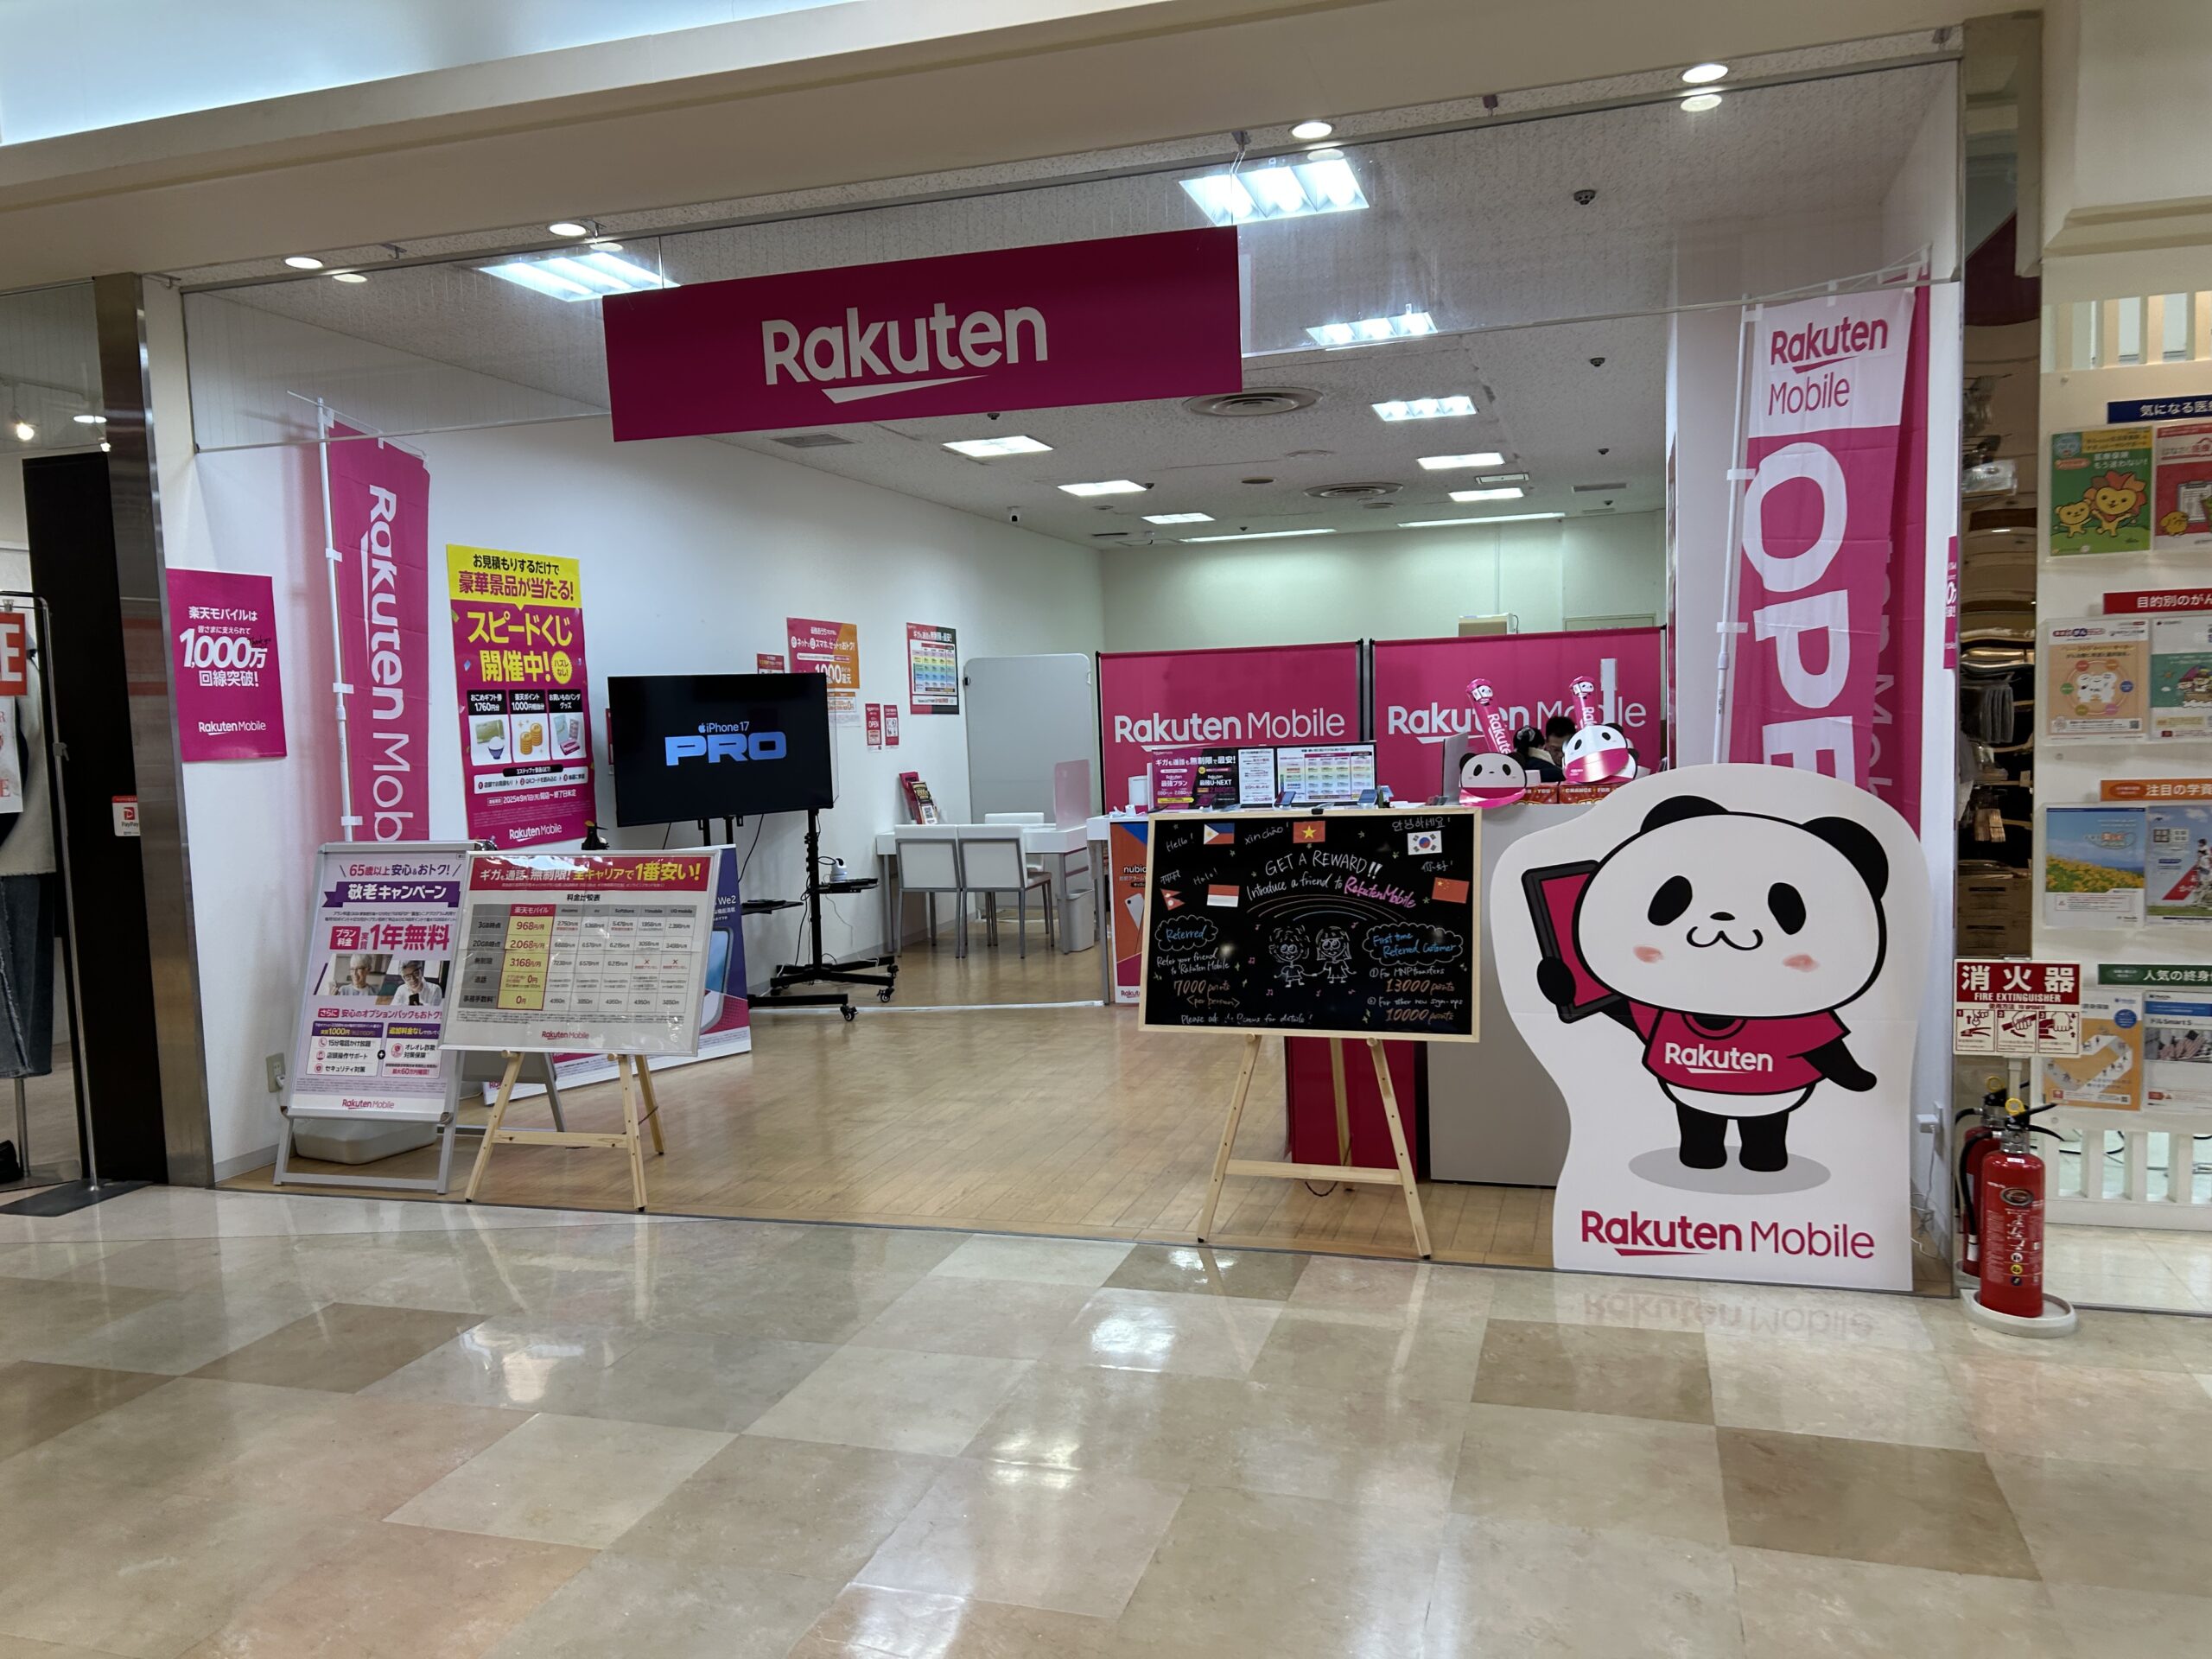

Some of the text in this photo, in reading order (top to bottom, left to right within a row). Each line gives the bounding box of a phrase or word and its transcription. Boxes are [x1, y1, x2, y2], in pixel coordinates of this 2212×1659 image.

[761, 303, 1048, 385] Rakuten
[1771, 317, 1888, 365] Rakuten
[1769, 372, 1850, 416] Mobile
[2139, 401, 2212, 416] 気になる医
[473, 554, 559, 575] お見積もりするだけで
[458, 570, 574, 601] 豪華景品が当たる!
[188, 606, 258, 621] 楽天モバイルは
[1742, 442, 1856, 786] OPE
[467, 610, 573, 646] スピードくじ
[370, 485, 413, 842] Rakuten Mob
[480, 650, 551, 682] 開催中!
[199, 671, 259, 687] 回線突破!
[1115, 708, 1344, 743] Rakuten Mobile
[1388, 702, 1529, 735] Rakuen
[1537, 696, 1646, 728] Mole
[198, 721, 266, 733] Rakuten Mobile
[706, 721, 749, 733] iPhone 17
[1487, 713, 1511, 753] Rakute
[664, 731, 787, 766] PRO
[509, 823, 562, 840] Rakuten Mobile
[1166, 832, 1194, 852] Hello!
[349, 864, 390, 876] 65歳以上
[1265, 854, 1294, 876] GET
[1299, 853, 1306, 865] A
[347, 883, 447, 900] 敬老キャンペーン
[1247, 880, 1287, 901] Introduce
[1300, 871, 1332, 887] friend
[1335, 876, 1343, 889] to
[718, 895, 736, 905] We2
[337, 938, 353, 947] 料金
[370, 924, 450, 950] 1年無料
[1166, 925, 1207, 942] Referred
[1193, 947, 1218, 961] friend
[1961, 965, 2075, 993] 消火器
[2143, 969, 2212, 982] 人気の終身
[1173, 980, 1206, 995] 7000
[1386, 979, 1431, 993] 13000
[1974, 993, 2062, 1002] FIRE EXTINGUISHER
[320, 1009, 339, 1018] さらに
[1386, 1007, 1429, 1021] 10000
[1664, 1042, 1773, 1072] Rakuten
[342, 1099, 395, 1109] Rakuten Mobile
[1581, 1211, 1875, 1259] Rakuten Mobile
